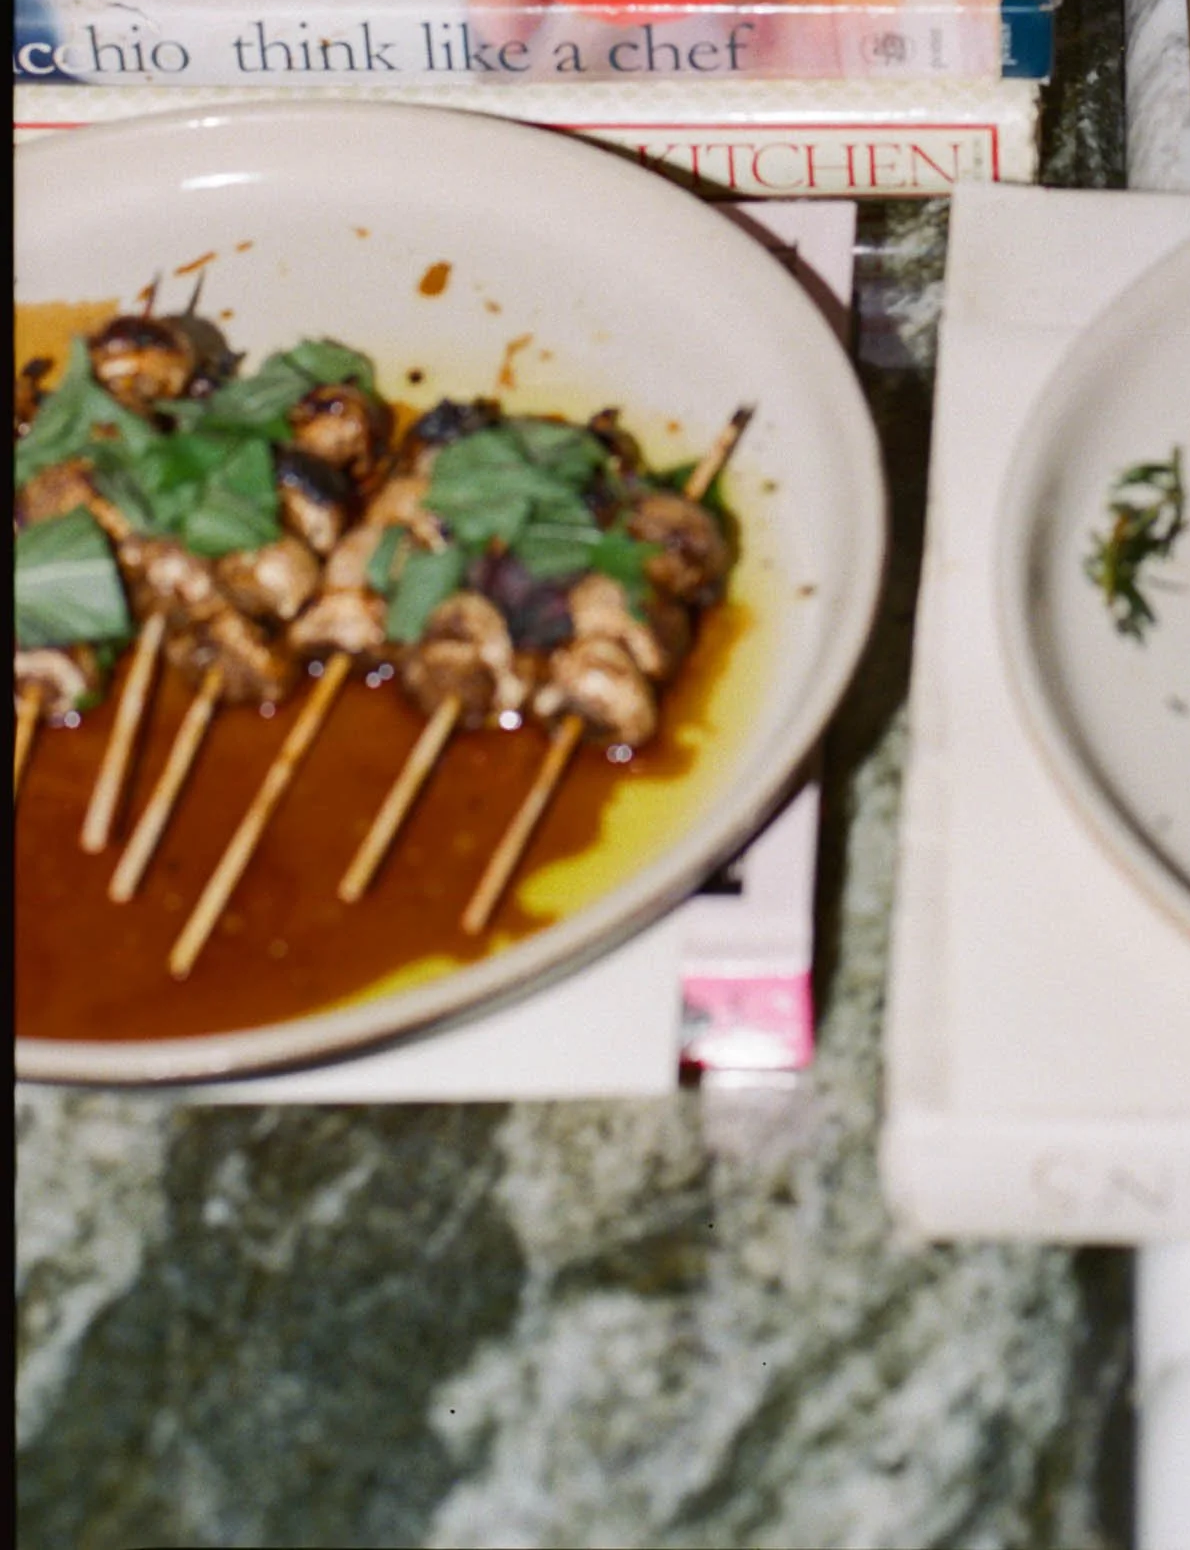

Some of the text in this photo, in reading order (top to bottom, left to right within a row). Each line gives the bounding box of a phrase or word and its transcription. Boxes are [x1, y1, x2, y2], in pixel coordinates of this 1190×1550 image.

[14, 21, 756, 75] cchio think like a chef
[637, 141, 960, 191] KITCHEN
